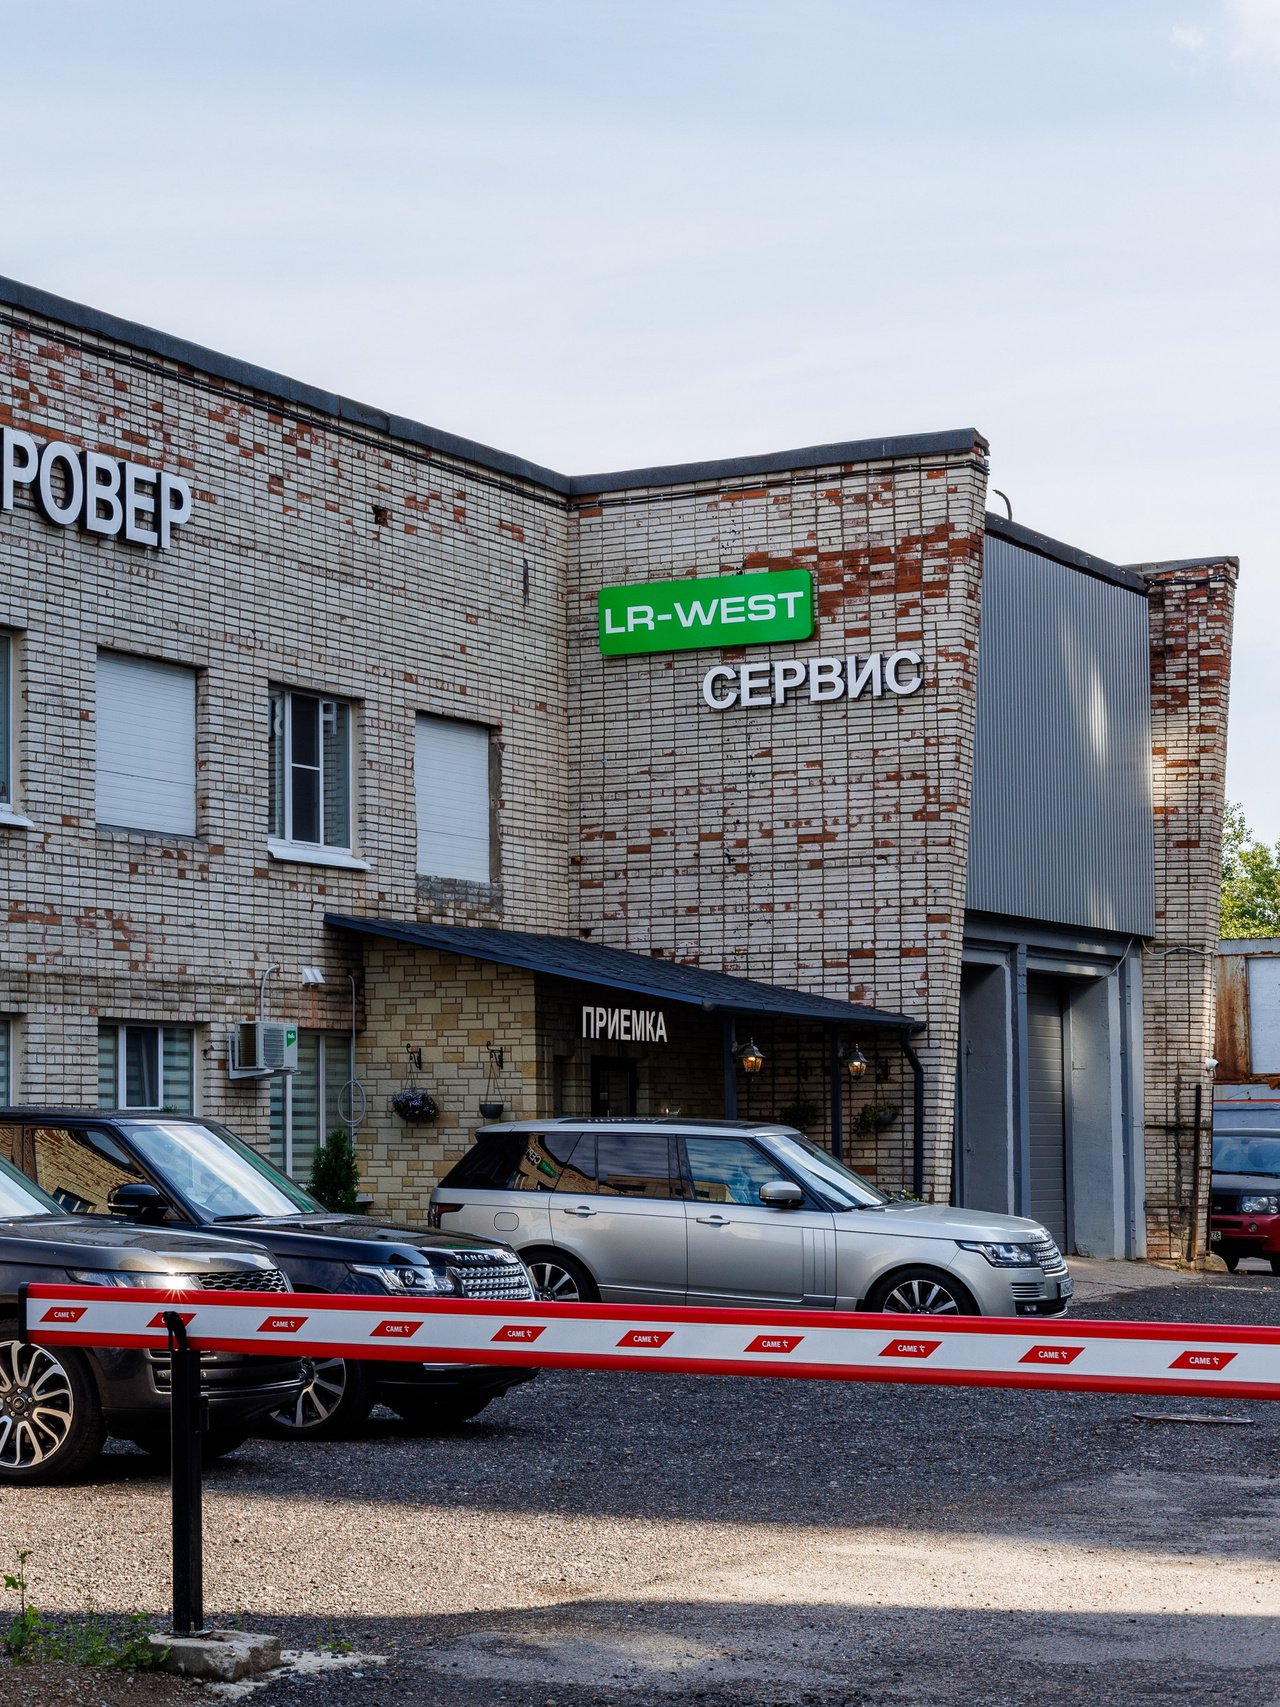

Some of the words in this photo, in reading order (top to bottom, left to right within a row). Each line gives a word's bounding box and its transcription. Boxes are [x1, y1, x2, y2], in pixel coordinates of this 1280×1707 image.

[604, 590, 805, 635] LR-WEST
[702, 649, 923, 711] СЕРВИС
[582, 1005, 668, 1043] ПРИЕМКА
[455, 1254, 491, 1262] RANGE
[54, 1311, 70, 1319] CAME
[271, 1320, 289, 1328] CAME
[385, 1325, 403, 1333] CAME
[507, 1330, 525, 1338] CAME
[633, 1335, 652, 1343] CAME
[761, 1340, 781, 1348] CAME
[897, 1344, 918, 1352] CAME
[1038, 1350, 1059, 1359] CAME
[1188, 1356, 1211, 1365] CAME
